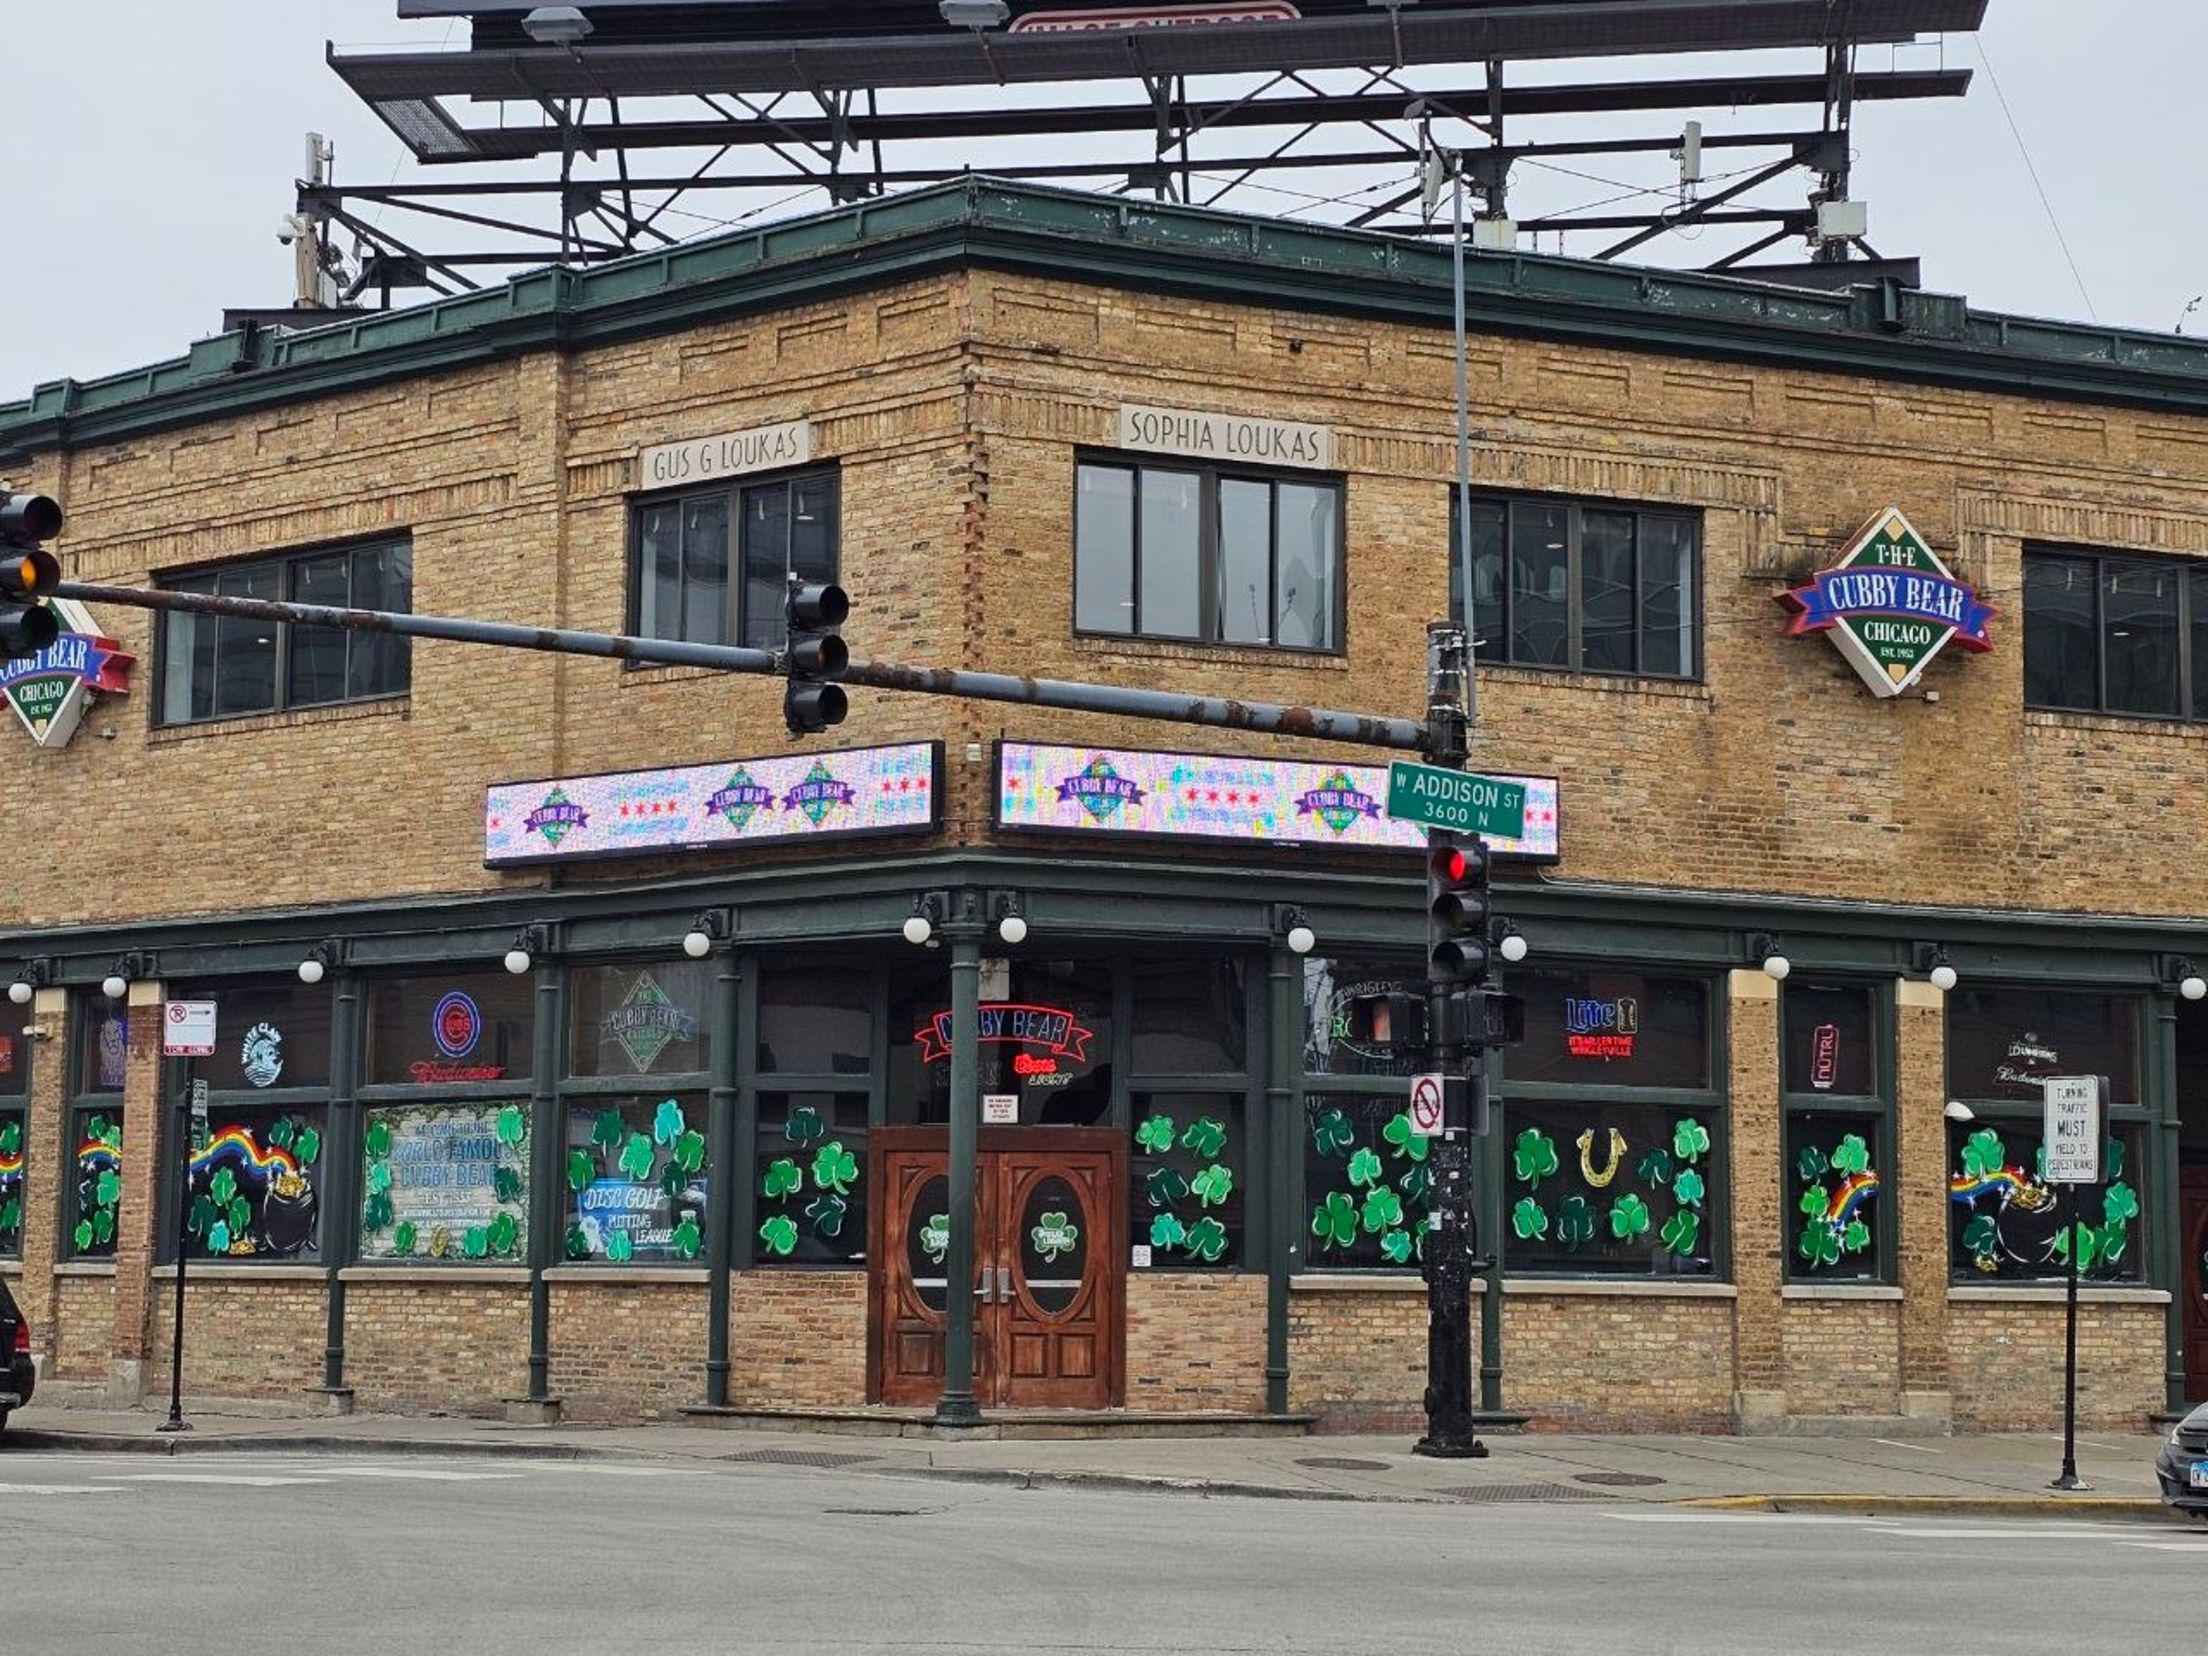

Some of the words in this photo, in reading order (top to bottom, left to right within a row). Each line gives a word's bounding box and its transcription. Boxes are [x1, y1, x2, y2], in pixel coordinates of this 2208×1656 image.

[1129, 411, 1214, 450] SOPHIA
[1226, 422, 1319, 461] LOUKAS
[654, 446, 690, 480] GUS
[700, 444, 712, 473] G
[722, 427, 797, 469] LOUKAS
[1828, 573, 1900, 610] CUBBY
[1906, 577, 1964, 622] BEAR
[1864, 620, 1932, 645] CHICAGO
[47, 637, 88, 671] BEAR
[20, 681, 64, 703] CHICAGO
[1396, 772, 1407, 789] W
[1413, 773, 1499, 808] ADDISON
[1504, 793, 1520, 809] ST
[1424, 802, 1469, 823] 3600
[1478, 811, 1489, 826] N
[1013, 1010, 1066, 1043] BEAR
[1566, 998, 1616, 1033] Lite
[241, 1026, 260, 1064] WHITE
[2057, 1088, 2089, 1099] TURNING
[2057, 1103, 2089, 1114] TRAFFIC
[2057, 1120, 2086, 1137] MUST
[2055, 1143, 2075, 1155] YIELD
[401, 1165, 451, 1188] CUBBY
[2048, 1158, 2093, 1171] PEDESTRIANS
[584, 1188, 621, 1210] DISC
[625, 1187, 663, 1210] GOLF
[634, 1228, 674, 1244] LEAGUE
